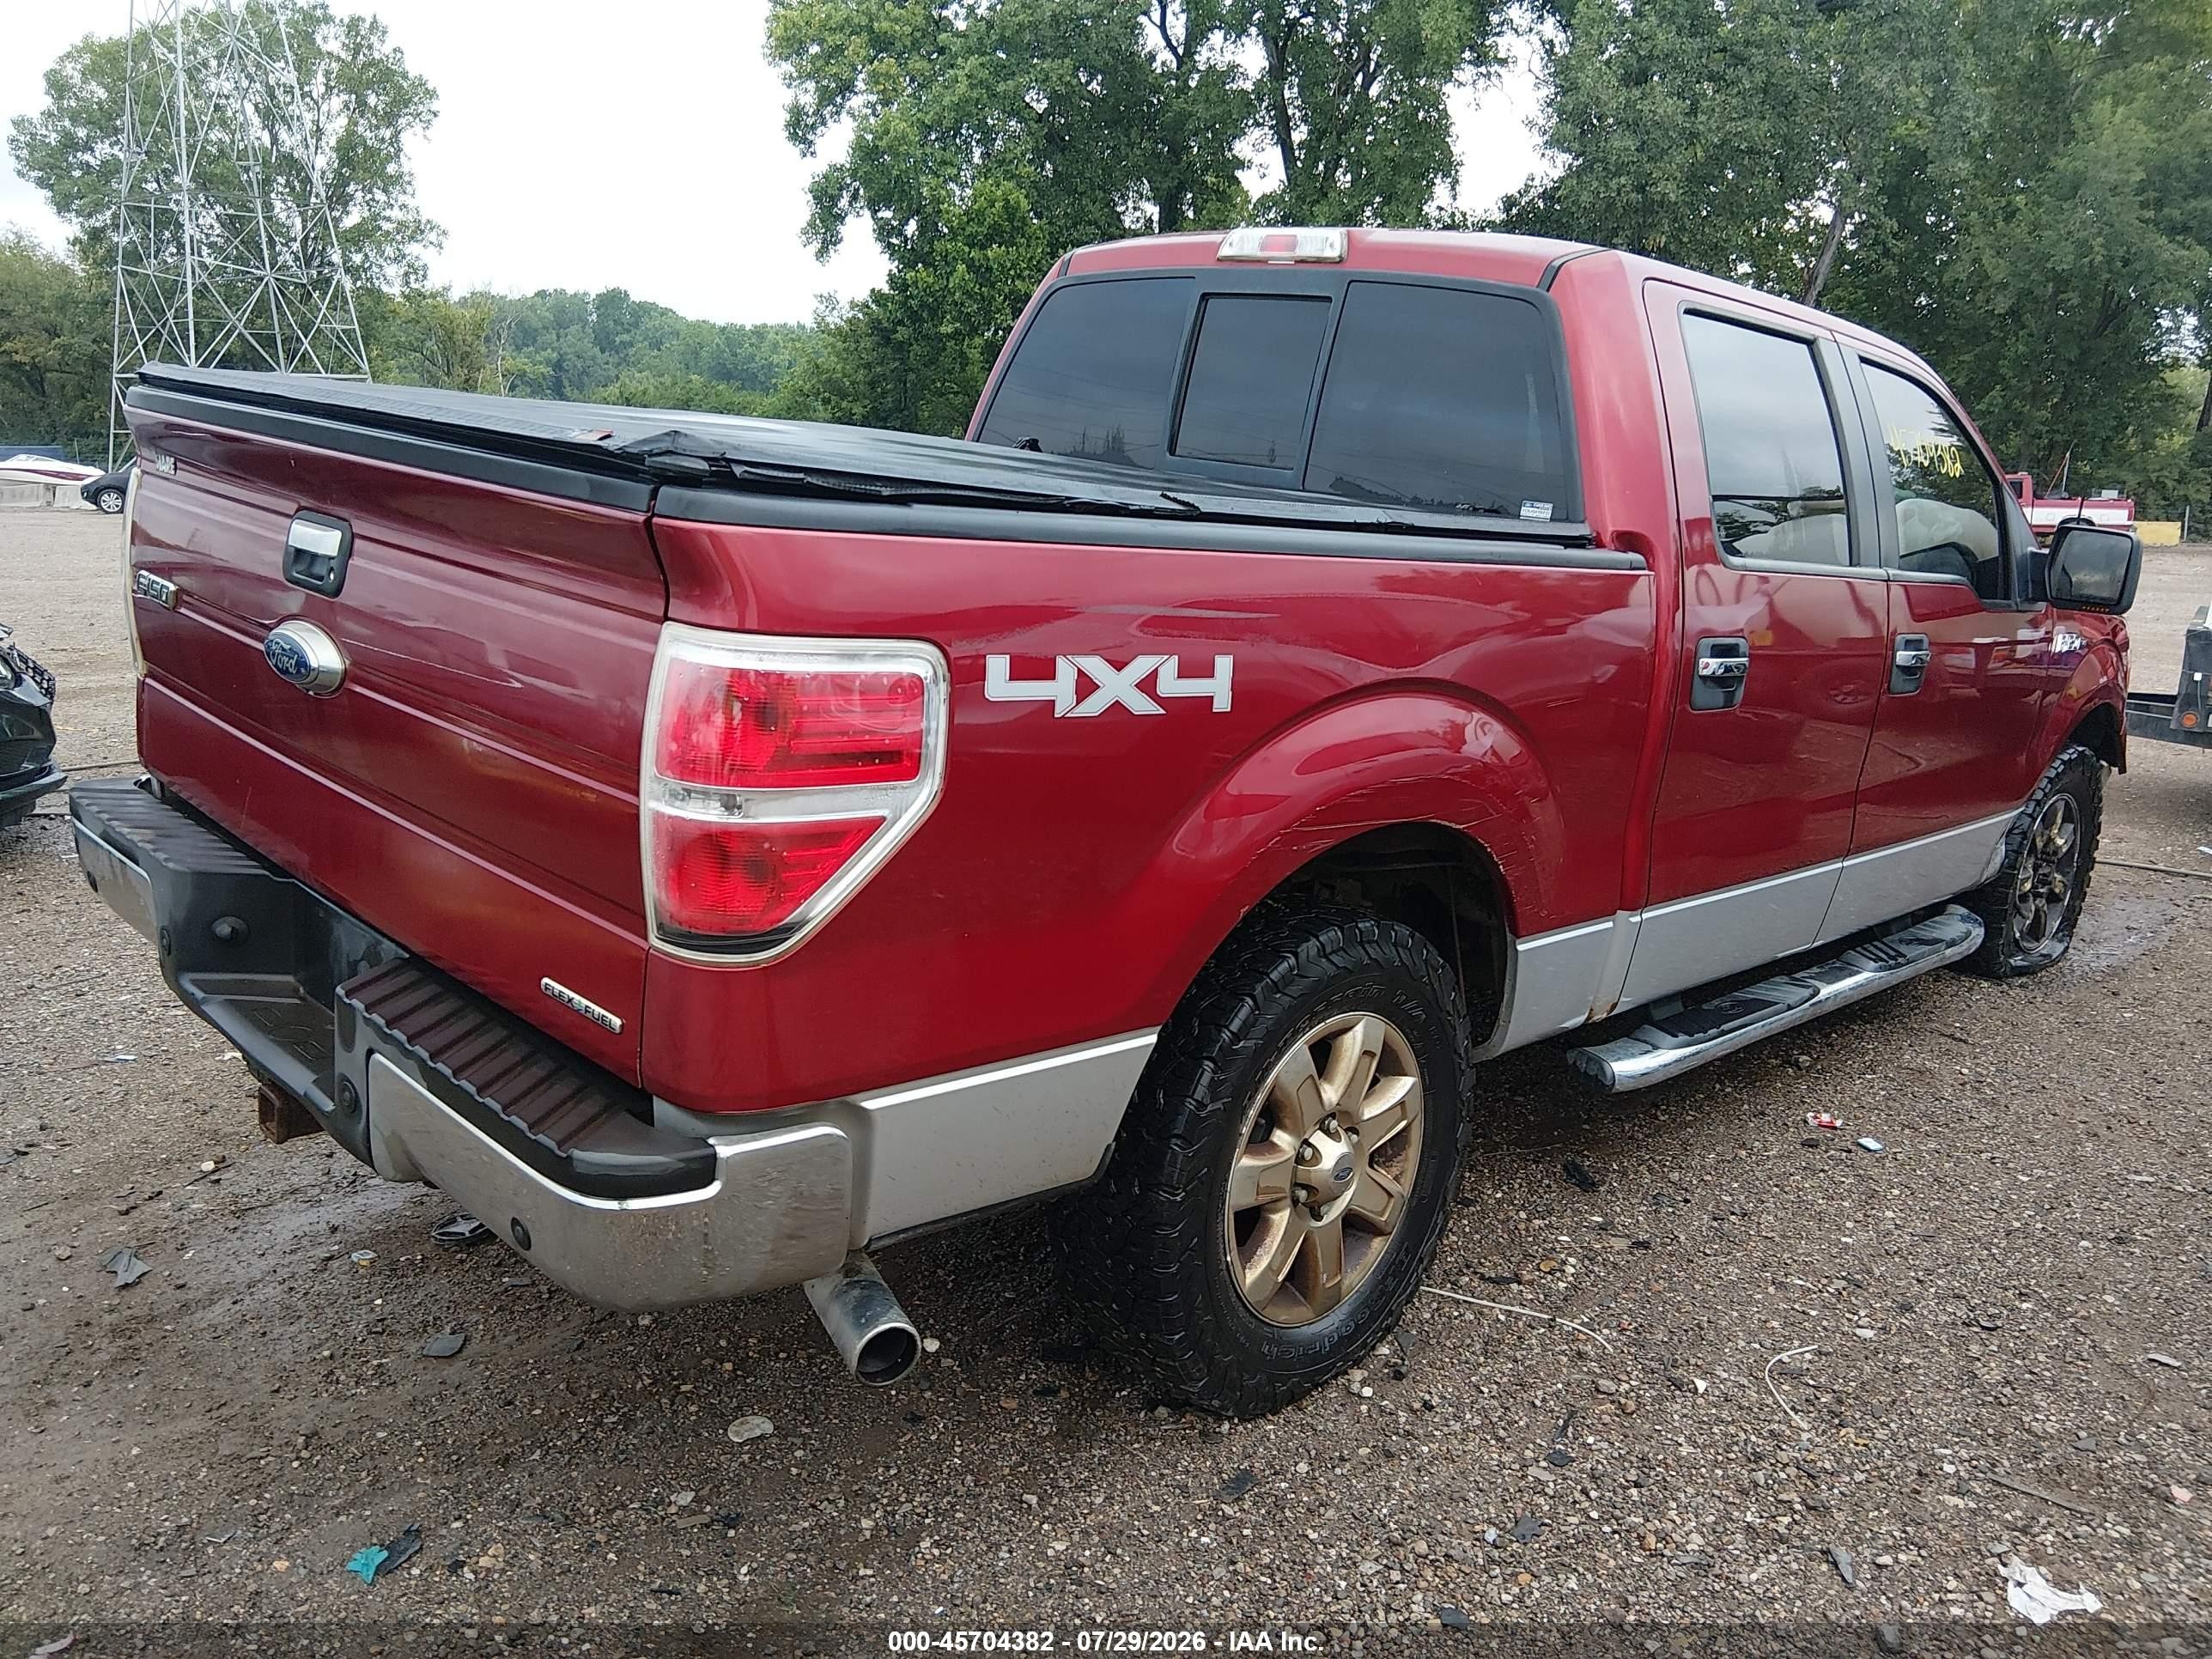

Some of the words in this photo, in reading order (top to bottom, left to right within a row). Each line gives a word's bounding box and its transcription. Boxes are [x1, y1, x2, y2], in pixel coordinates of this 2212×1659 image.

[270, 638, 298, 674] Ford
[544, 982, 574, 1008] FLEX
[584, 1005, 617, 1032] FUEL
